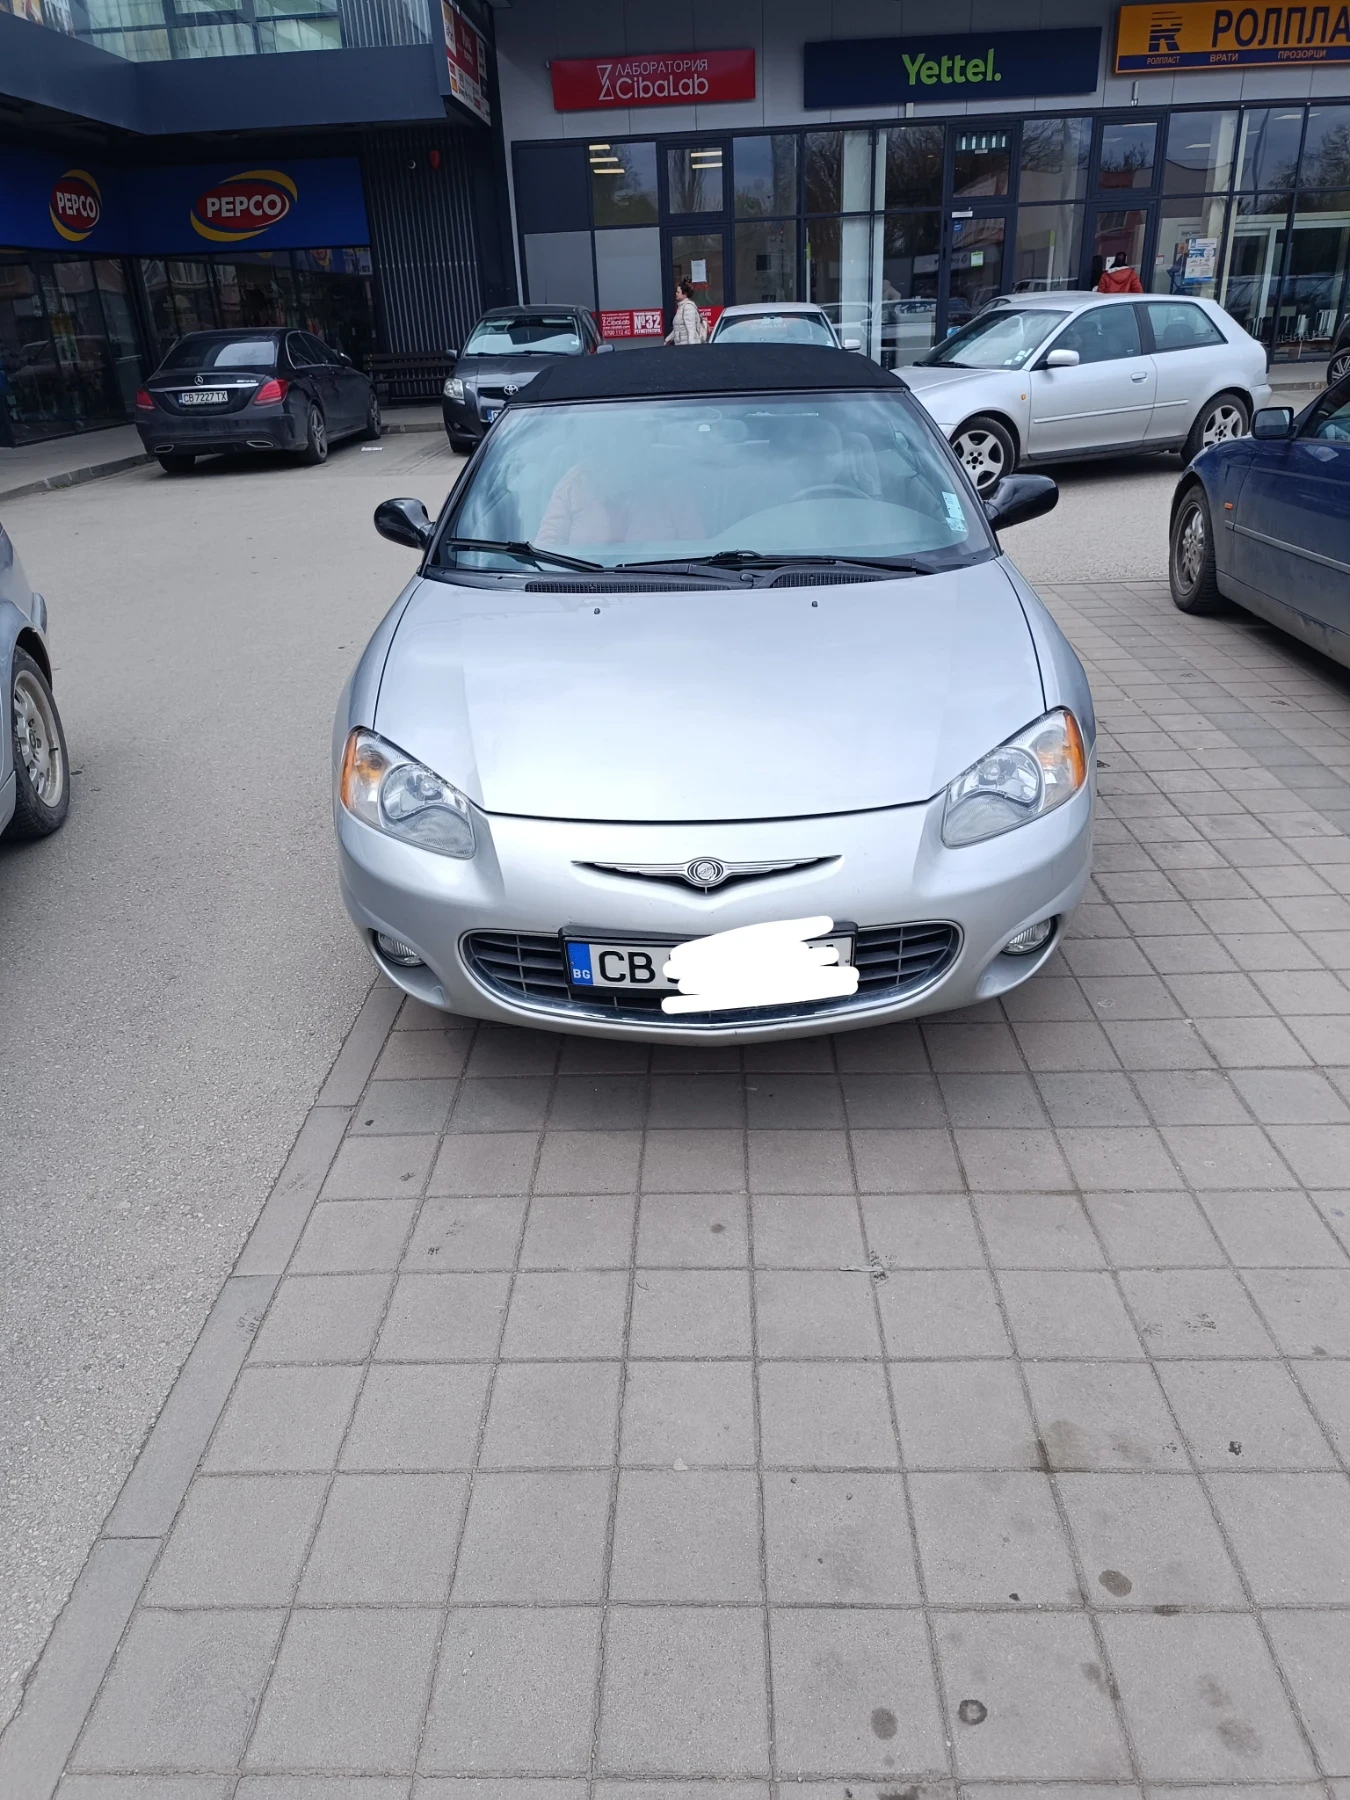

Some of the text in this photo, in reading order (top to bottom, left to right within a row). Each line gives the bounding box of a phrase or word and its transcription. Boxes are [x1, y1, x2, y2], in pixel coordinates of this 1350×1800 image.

[1146, 55, 1181, 65] РОЛПЛАСТ
[1209, 53, 1239, 63] ВРАТИ
[1277, 49, 1327, 60] ПРОЗОРЦИ
[615, 59, 708, 76] ЛАБОРАТОРИЯ
[901, 48, 1002, 86] Yettel.
[615, 73, 709, 99] CibaLab
[56, 191, 97, 219] PEPCO
[206, 194, 283, 218] PEPCO
[183, 391, 226, 403] CB 7227 TX
[572, 967, 591, 980] BG
[598, 950, 656, 984] CB
